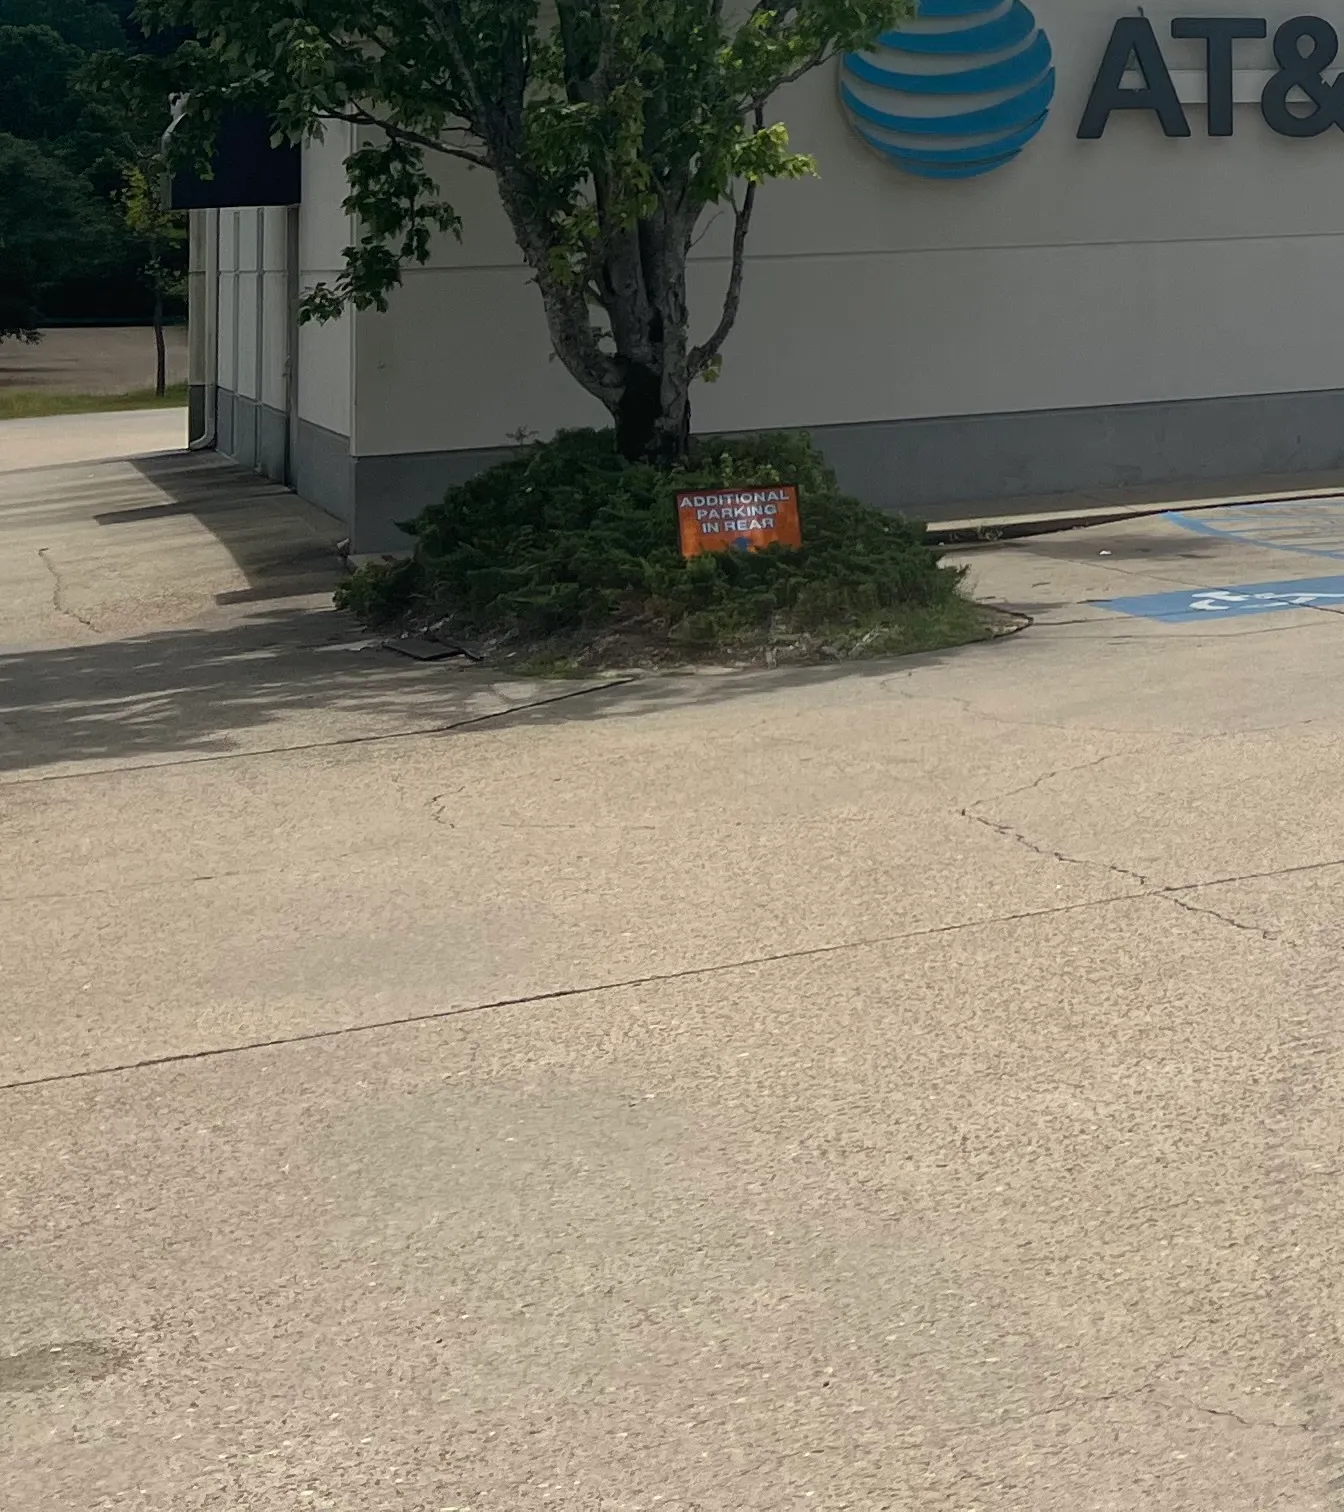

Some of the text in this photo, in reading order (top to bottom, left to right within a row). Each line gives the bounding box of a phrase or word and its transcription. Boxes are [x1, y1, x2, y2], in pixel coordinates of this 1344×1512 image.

[680, 489, 790, 508] ADDITIONAL
[697, 504, 777, 520] PARKING
[702, 517, 774, 534] IN REAR
